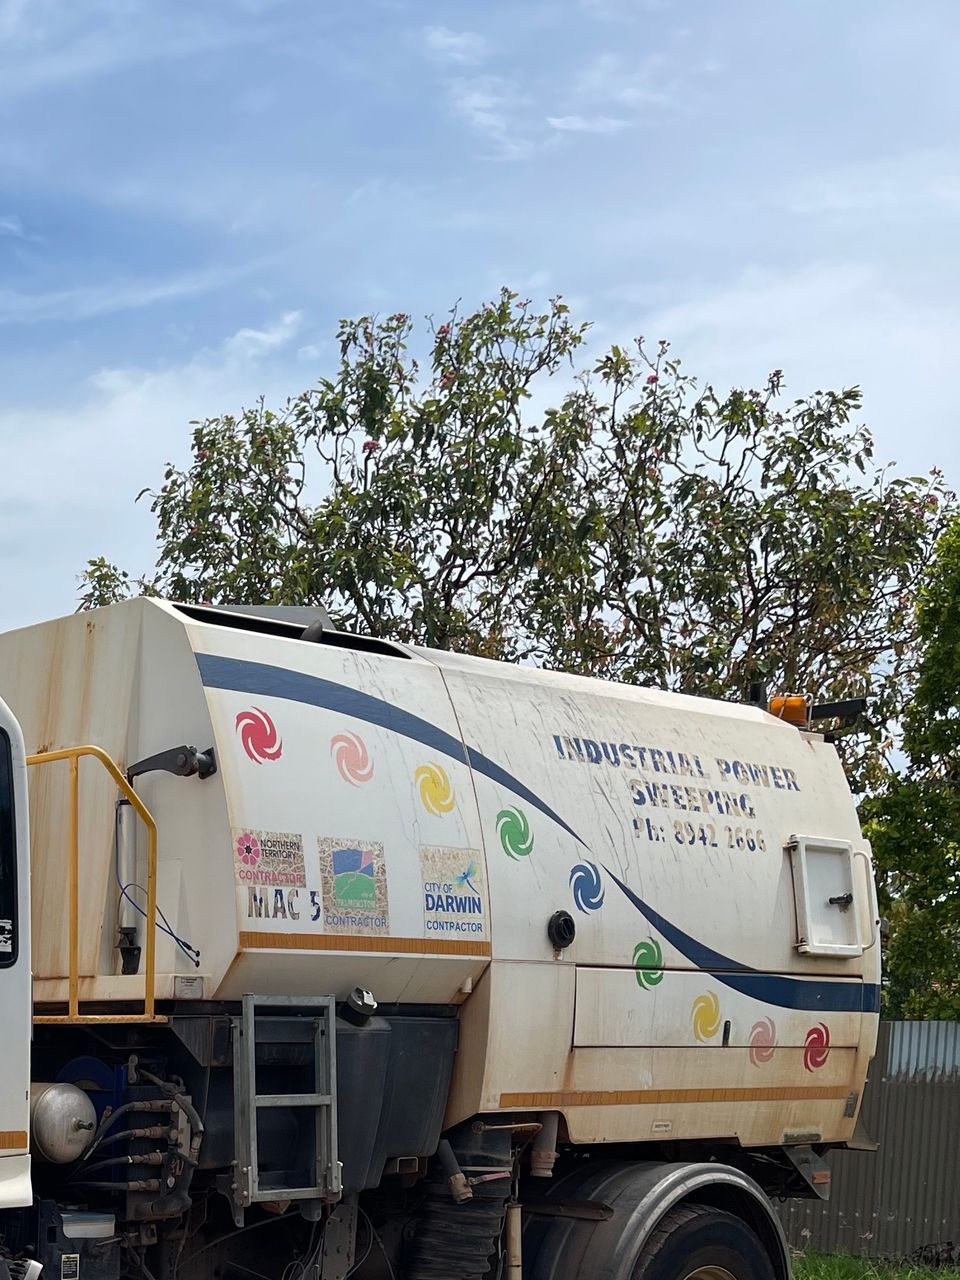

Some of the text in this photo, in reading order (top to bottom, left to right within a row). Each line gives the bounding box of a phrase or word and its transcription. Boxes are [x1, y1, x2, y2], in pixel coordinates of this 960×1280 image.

[553, 735, 801, 792] INDUSTRIAL POWER
[631, 779, 756, 819] SWEEPING
[674, 820, 718, 848] 8942
[724, 825, 767, 852] 2666
[260, 839, 300, 852] NORTHERN
[261, 848, 297, 860] TERRITORY
[239, 869, 304, 883] CONTRACTOR
[425, 882, 453, 894] CITY OF
[248, 886, 300, 920] MAC
[425, 893, 482, 914] DARWIN
[324, 915, 387, 928] CONTRACTOR
[426, 920, 483, 933] CONTRACTOR
